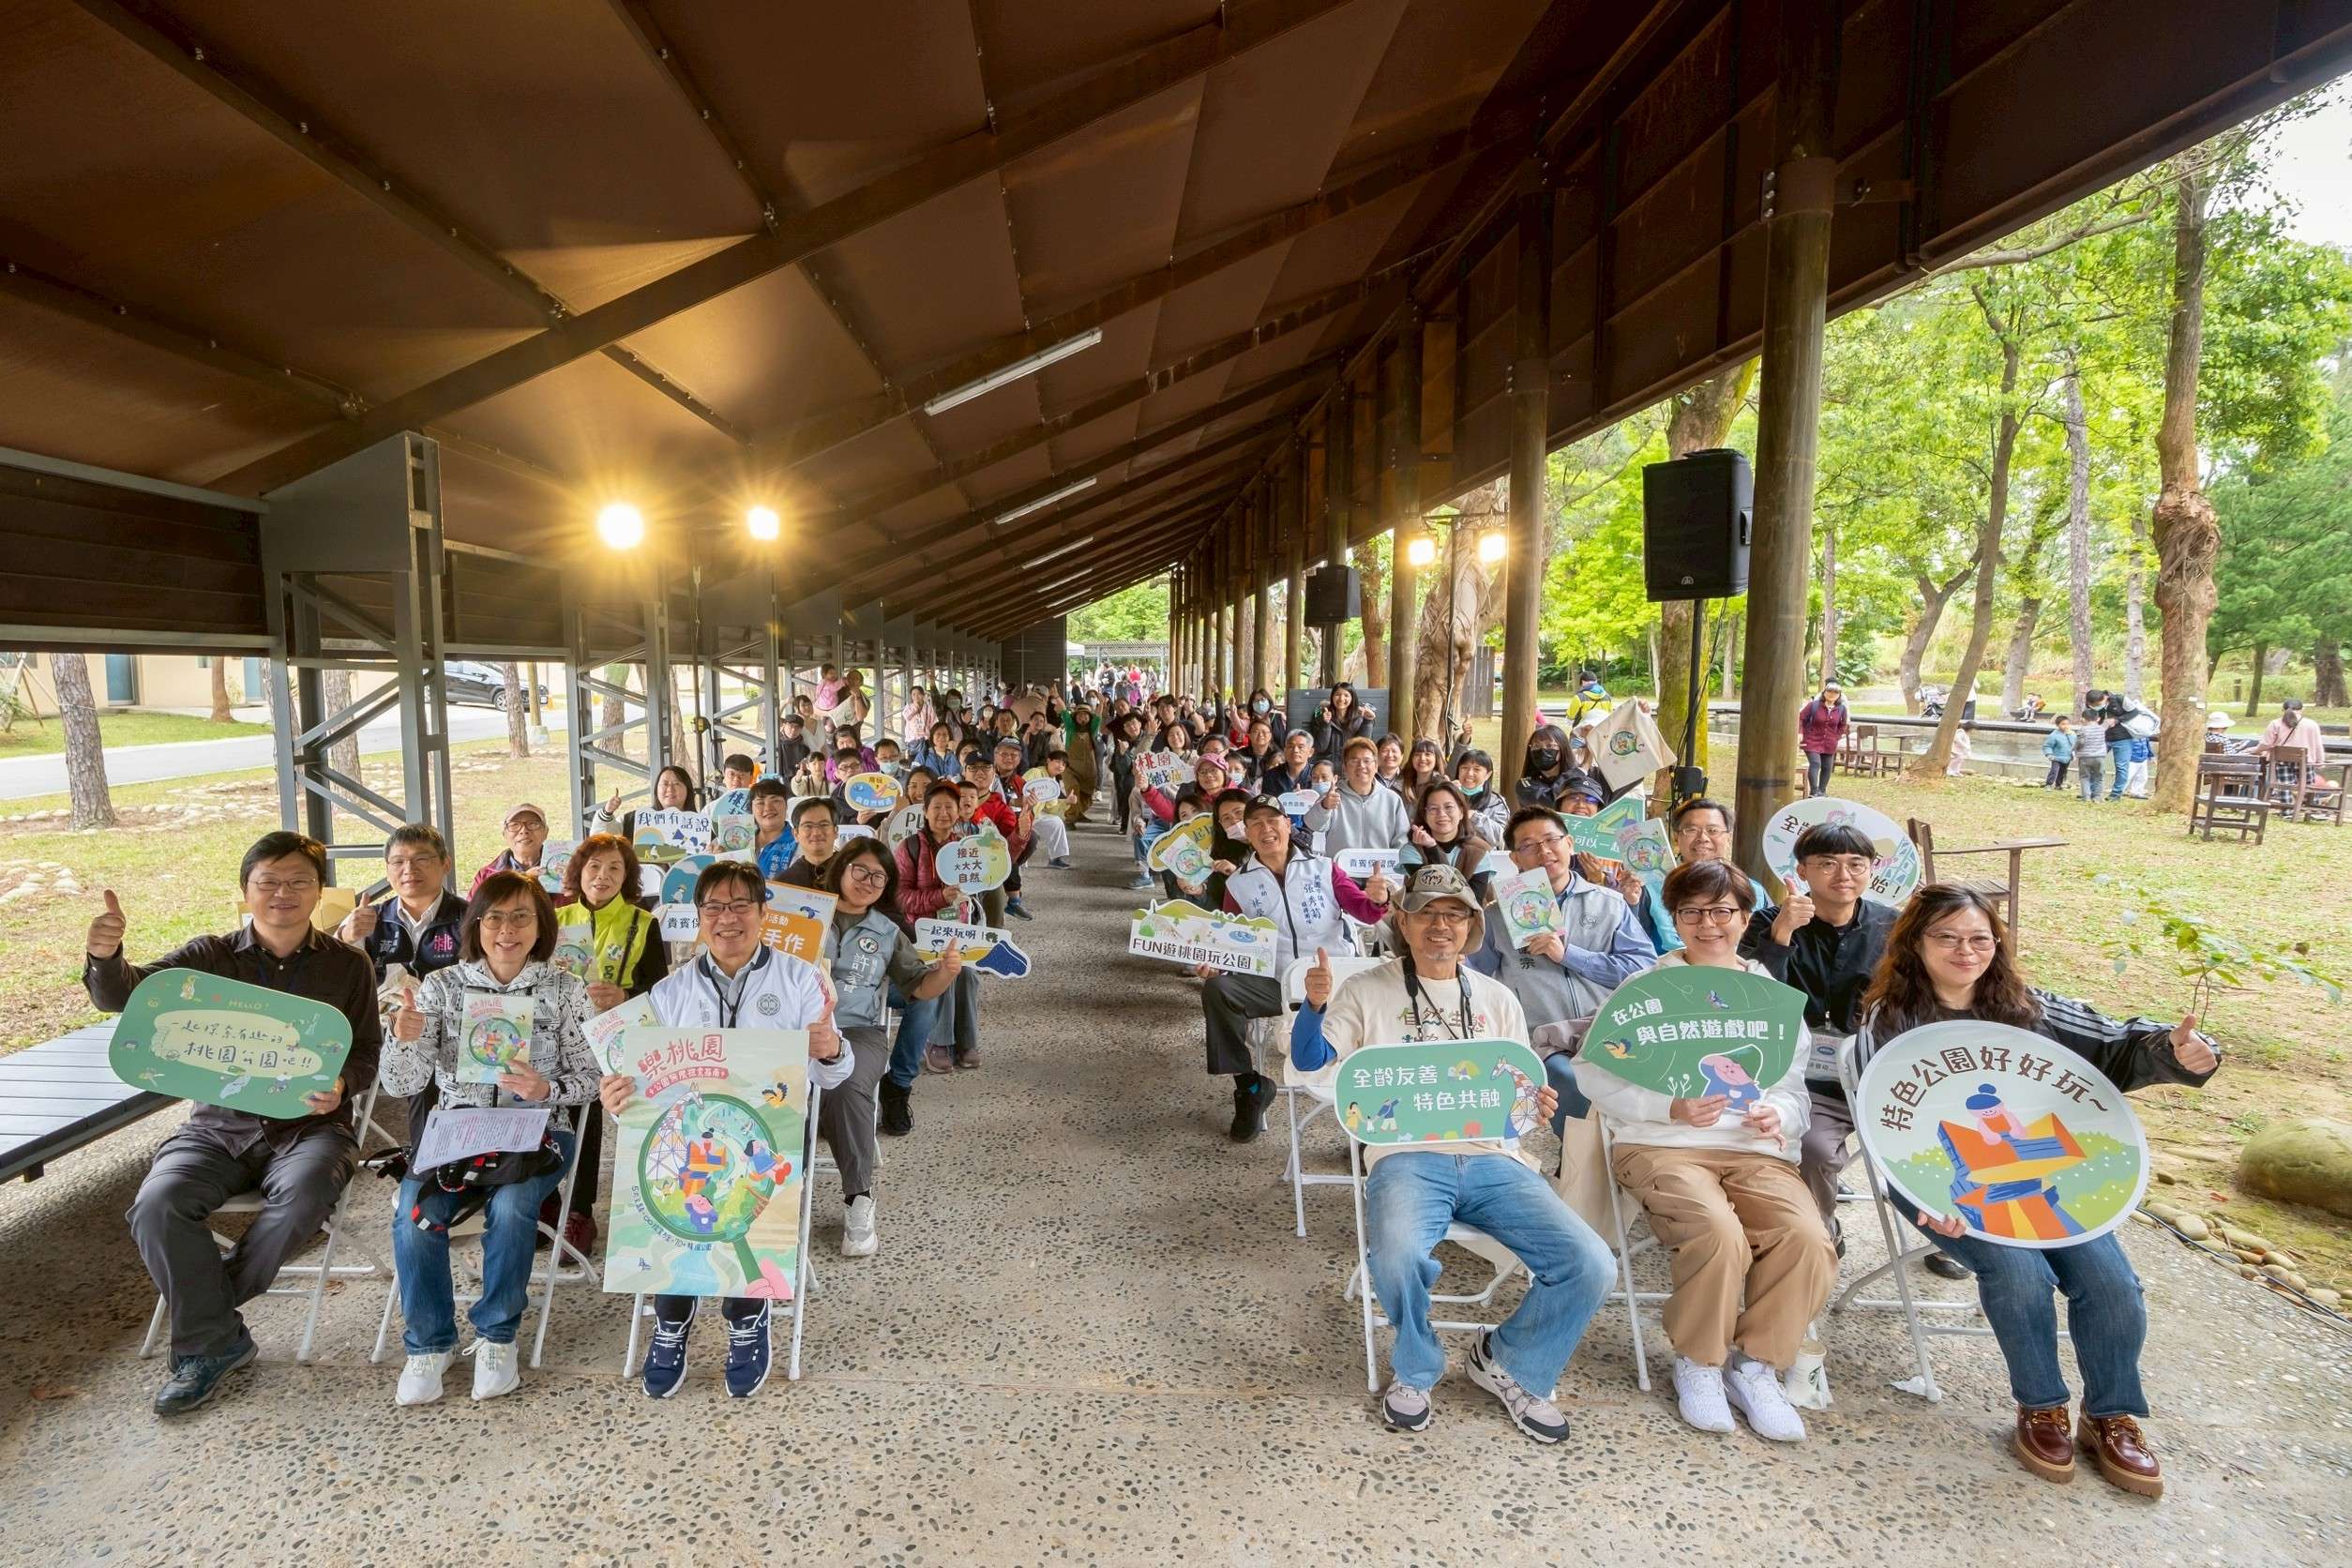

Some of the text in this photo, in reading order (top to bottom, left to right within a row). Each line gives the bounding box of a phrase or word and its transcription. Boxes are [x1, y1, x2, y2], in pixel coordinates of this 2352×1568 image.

[639, 810, 710, 833] 我們有話說
[955, 860, 983, 870] 大大大
[957, 848, 979, 859] 接近
[958, 873, 982, 883] 自然
[1133, 938, 1251, 970] FUN遊桃園玩公園
[1610, 998, 1664, 1026] 在公園
[1636, 1018, 1785, 1046] 與自然遊戲吧！
[638, 1033, 727, 1081] 樂桃園
[1353, 1065, 1439, 1089] 全齡友善
[1413, 1089, 1501, 1112] 特色共融
